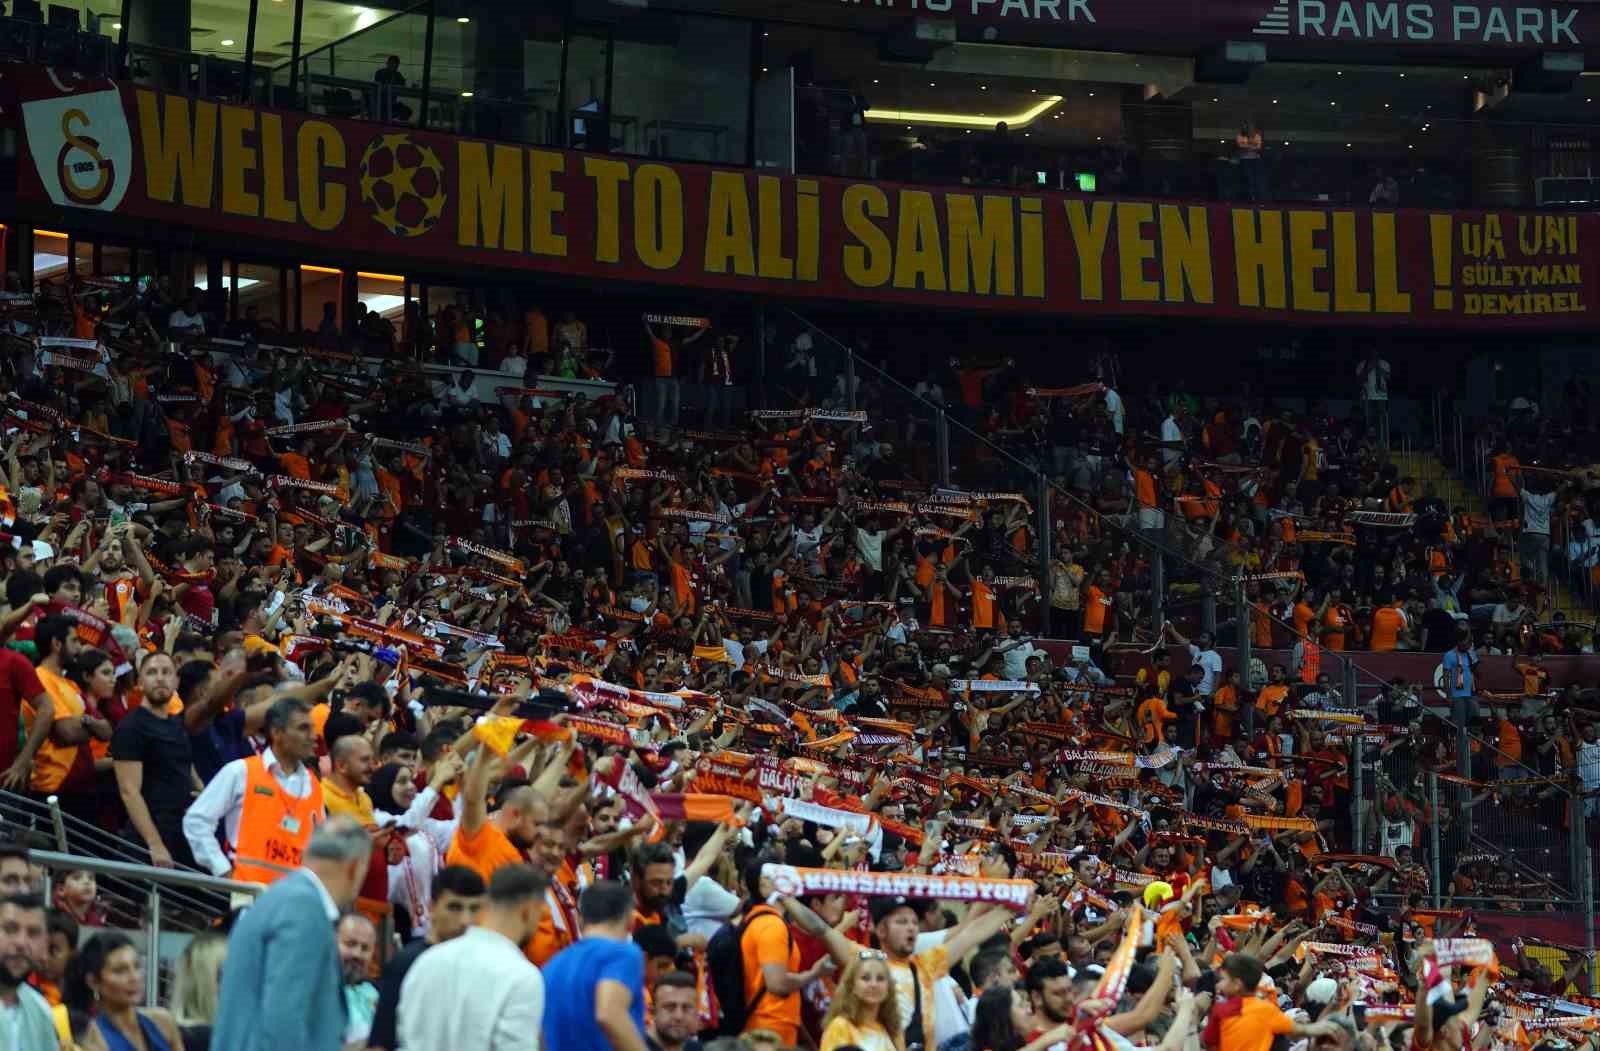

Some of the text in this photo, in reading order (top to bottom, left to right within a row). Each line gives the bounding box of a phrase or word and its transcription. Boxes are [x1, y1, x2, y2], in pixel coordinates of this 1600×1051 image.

[1299, 0, 1579, 44] RAMS PARK
[73, 161, 94, 173] 1905
[584, 156, 683, 270] TO
[1065, 200, 1214, 303] YEN
[1232, 209, 1411, 314] HELL
[1461, 262, 1582, 287] SÜLEYMAN
[1463, 289, 1586, 314] DEMİREL
[647, 313, 705, 328] GALATA
[803, 871, 1029, 906] KONSANTRASYON
